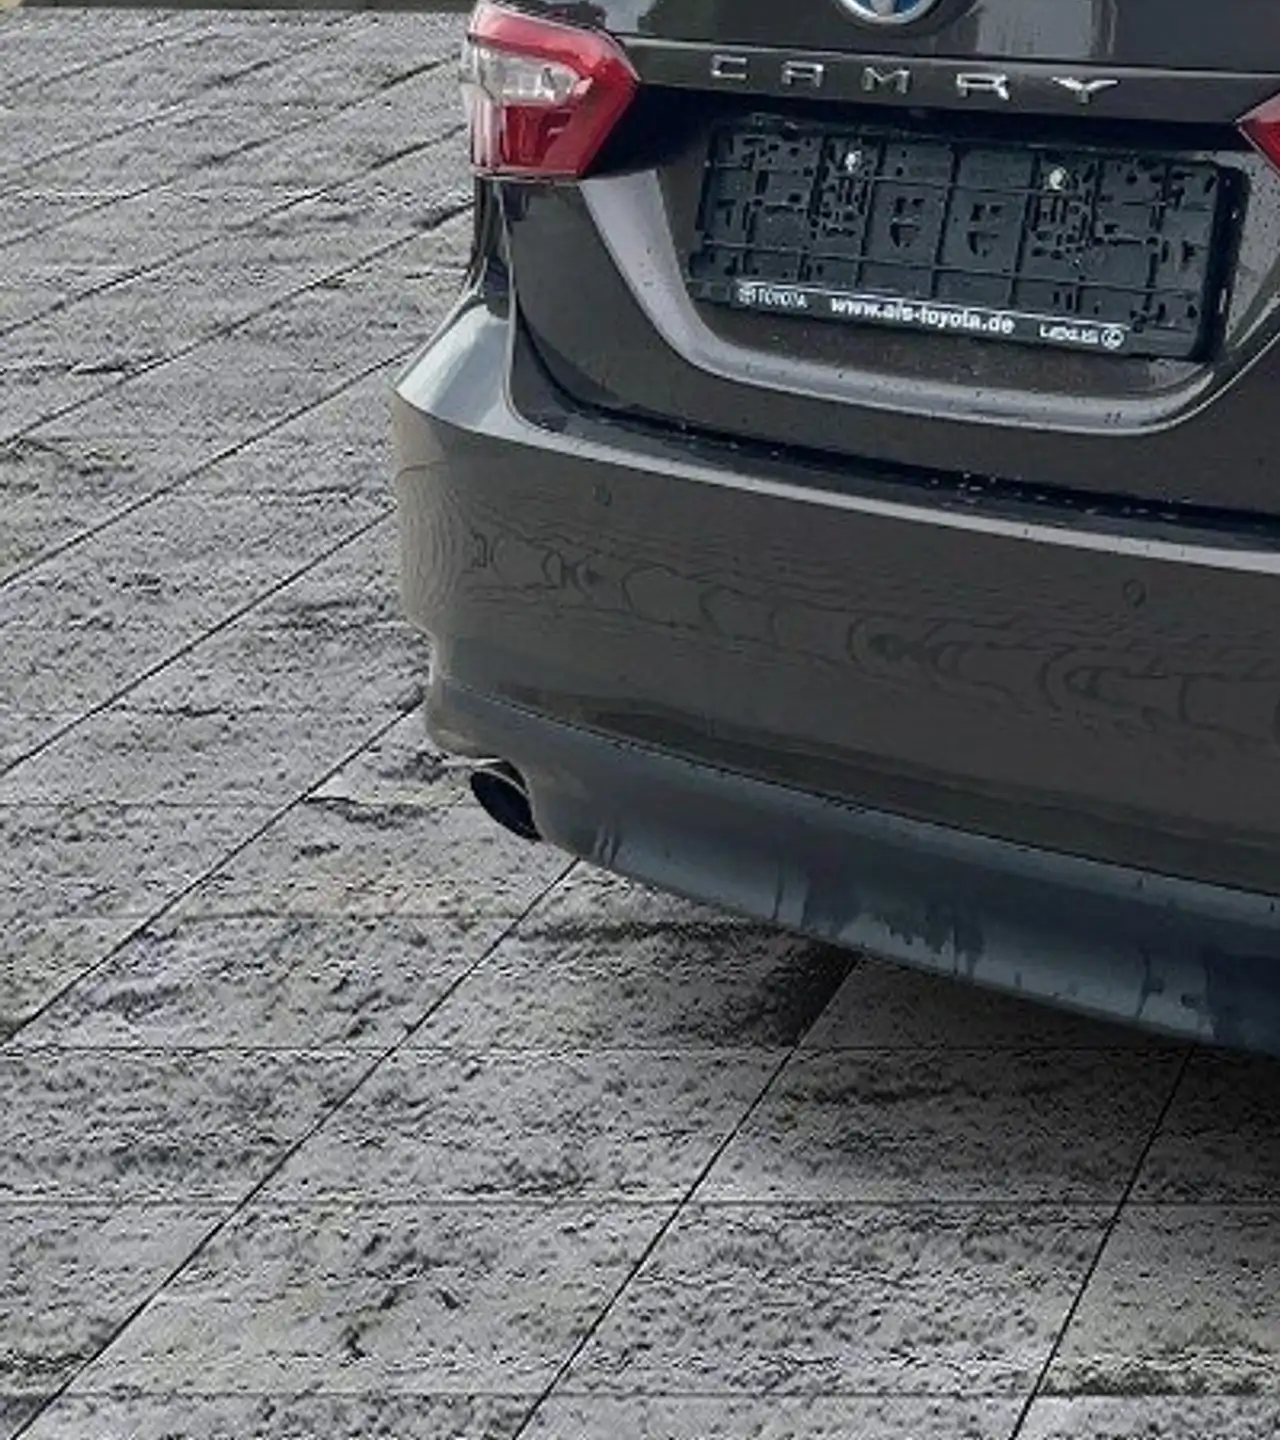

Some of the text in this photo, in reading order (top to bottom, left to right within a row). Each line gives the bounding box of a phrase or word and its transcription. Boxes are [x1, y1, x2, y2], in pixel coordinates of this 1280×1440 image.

[709, 53, 1119, 104] CAMRY
[758, 288, 808, 309] TOYOTA
[831, 296, 1016, 335] www.ais-toyota.de
